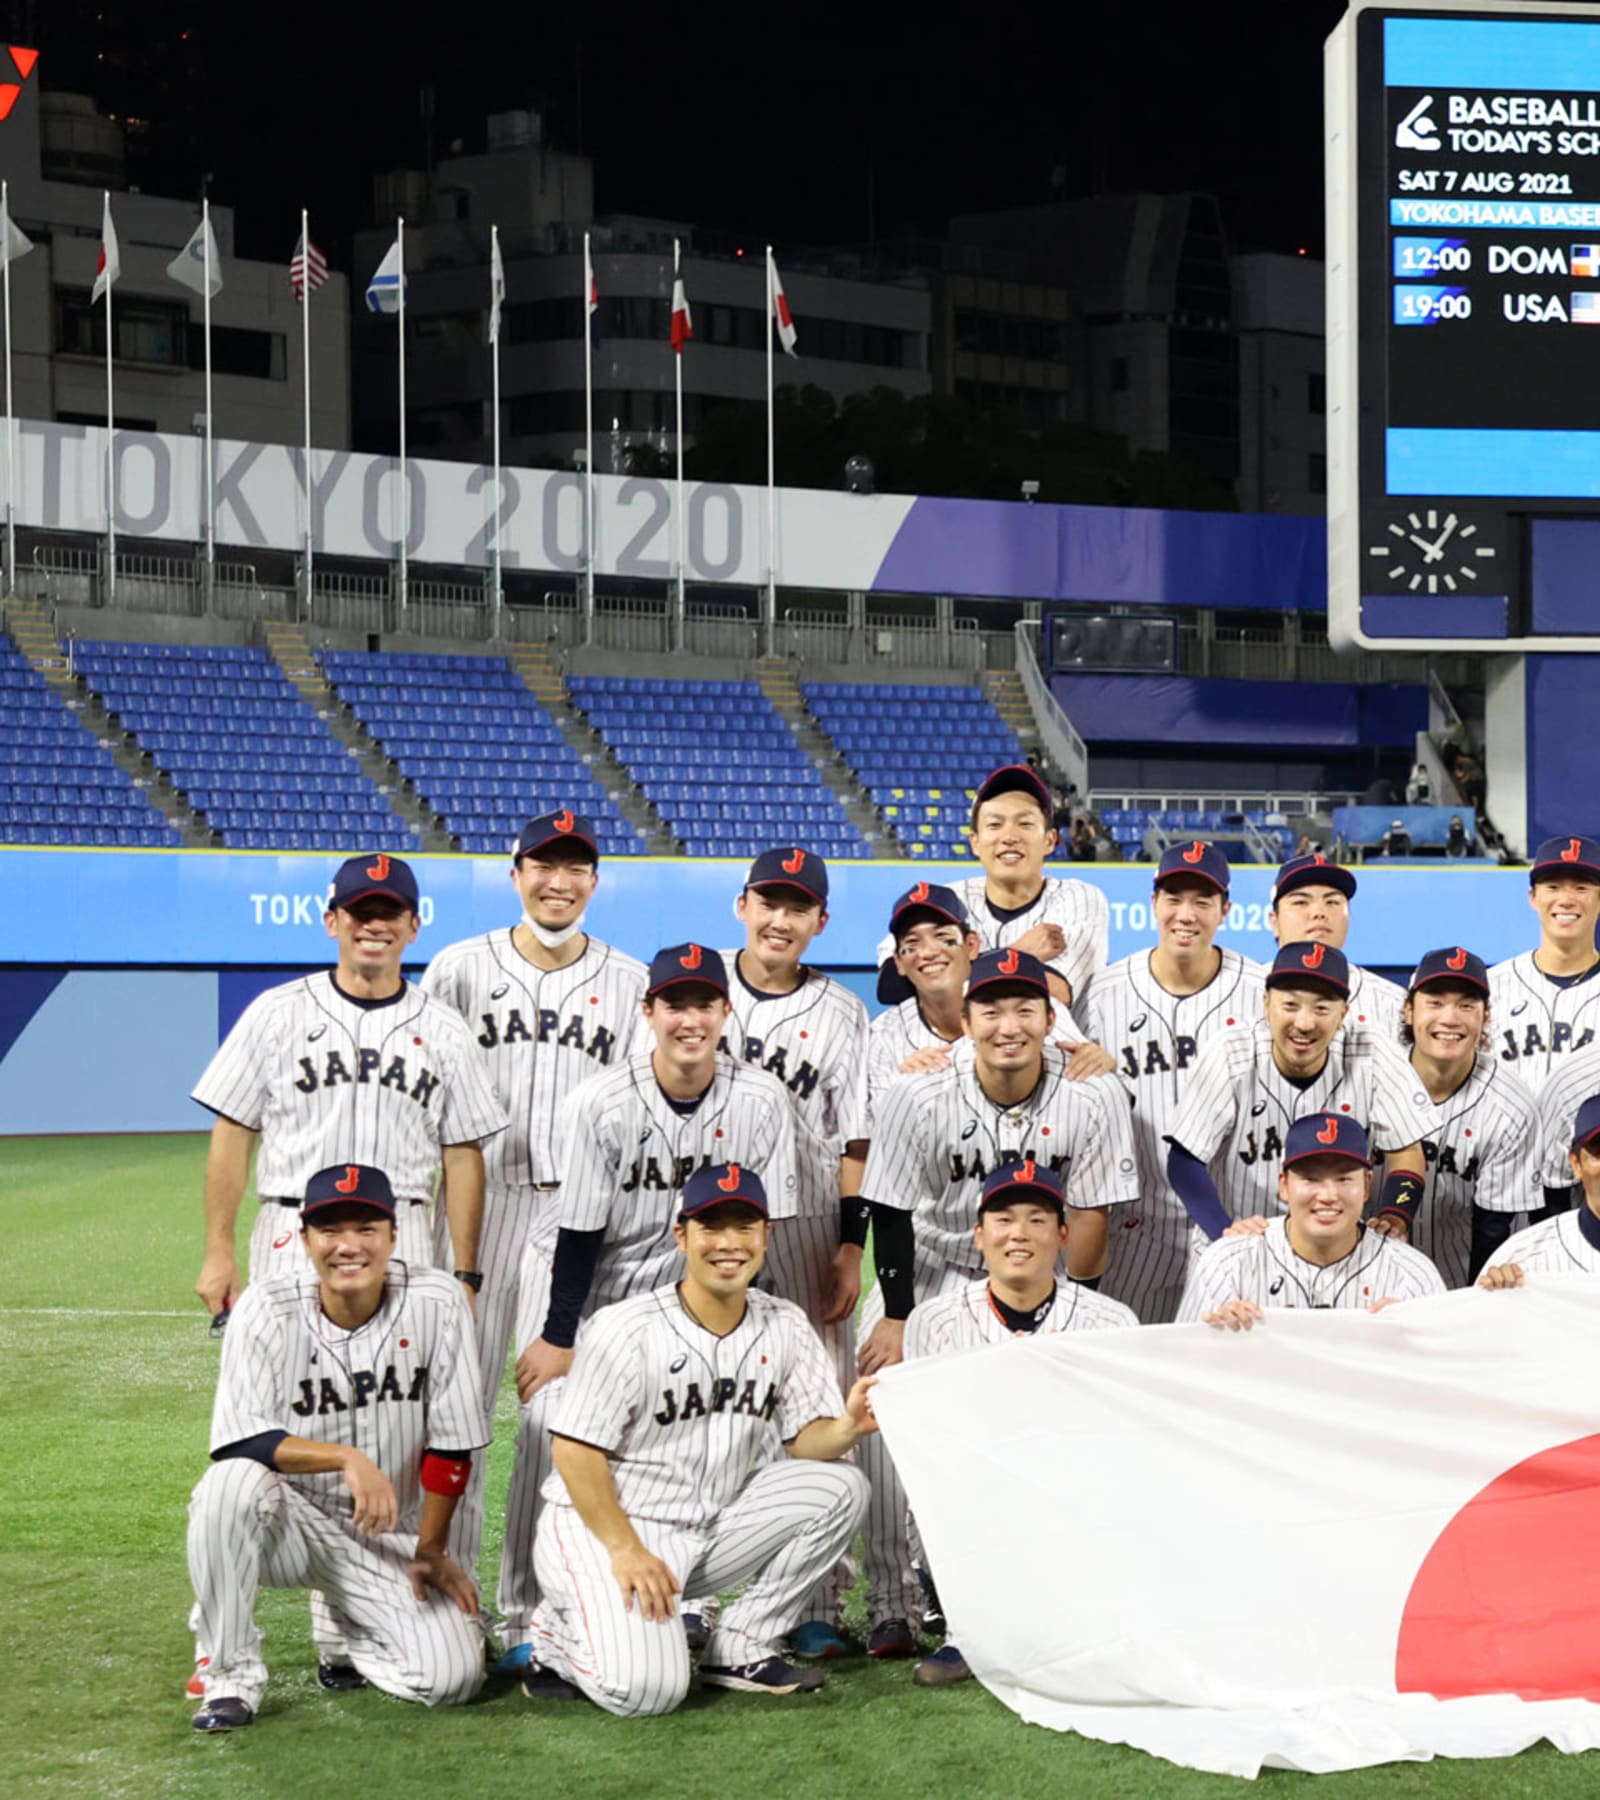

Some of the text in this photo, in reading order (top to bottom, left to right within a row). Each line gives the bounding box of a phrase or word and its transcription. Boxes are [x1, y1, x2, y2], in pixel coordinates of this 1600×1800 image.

[1448, 129, 1552, 154] TODAY'S
[1399, 170, 1572, 194] SAT 7 AUG 2021
[1399, 203, 1535, 225] YOKOHAMA
[1402, 247, 1471, 272] 12:00
[1488, 246, 1568, 275] DOM
[1402, 295, 1471, 320] 19:00
[1503, 294, 1568, 323] USA
[19, 419, 743, 578] TOKYO 2020
[553, 811, 575, 834] J
[782, 850, 806, 874] J
[1183, 841, 1205, 864] J
[1561, 839, 1581, 864] J
[368, 855, 391, 882] J
[909, 882, 930, 904] J
[250, 894, 329, 925] TOKY
[680, 945, 702, 970] J
[999, 948, 1020, 975] J
[1303, 944, 1326, 969] J
[1447, 949, 1467, 970] J
[477, 1009, 616, 1065] JAPAN
[1501, 1022, 1595, 1062] JAPA
[717, 1036, 819, 1100] PAN
[1120, 1036, 1198, 1080] JAP
[295, 1048, 440, 1108] JAPAN
[1318, 1118, 1338, 1144] J
[335, 1167, 360, 1194] J
[718, 1166, 741, 1192] J
[1014, 1160, 1036, 1184] J
